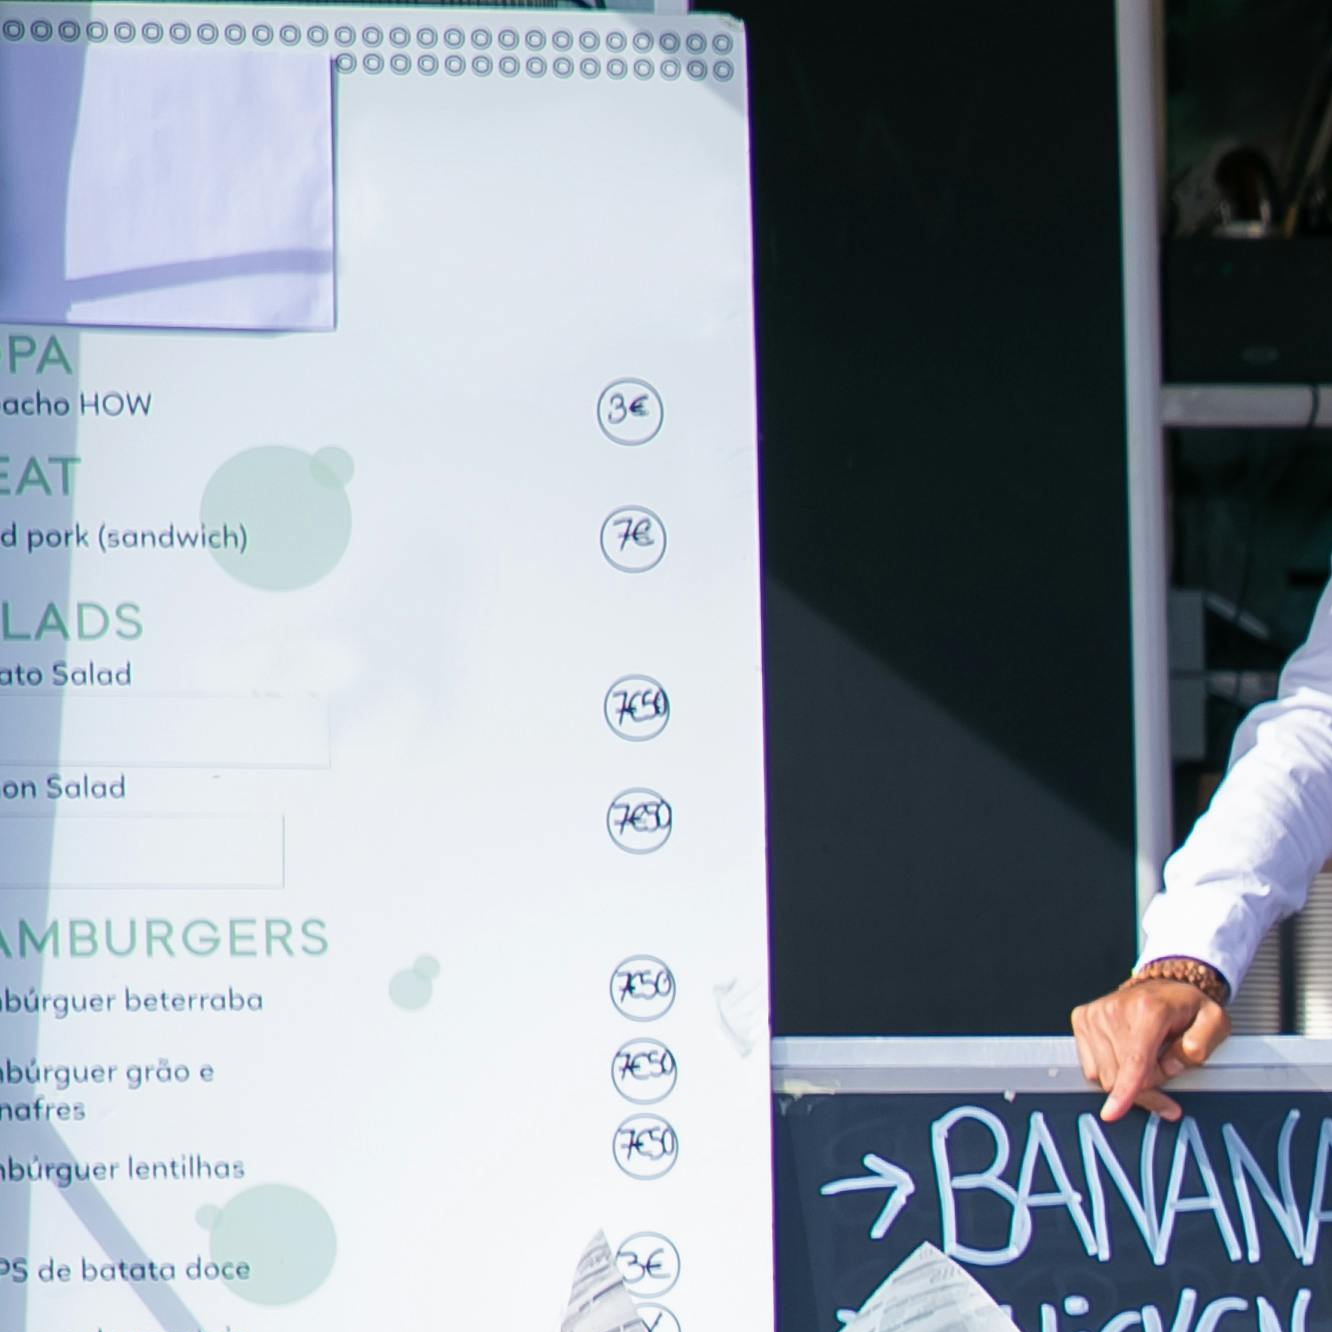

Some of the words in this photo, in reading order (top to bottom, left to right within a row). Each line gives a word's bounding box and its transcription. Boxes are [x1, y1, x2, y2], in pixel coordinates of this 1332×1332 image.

[0, 333, 72, 375] PA
[0, 389, 70, 416] acho
[80, 390, 152, 417] HOW
[607, 392, 650, 424] 3€
[28, 520, 89, 555] pork
[98, 521, 249, 555] (sandwich)
[612, 517, 655, 552] 7€
[2, 600, 143, 641] LADS
[52, 660, 131, 687] Salad
[0, 779, 36, 800] on
[46, 772, 125, 800] Salad
[0, 986, 117, 1020] búrguer
[125, 985, 264, 1013] beterraba
[0, 1057, 118, 1091] búrguer
[126, 1057, 191, 1090] grão
[199, 1063, 215, 1082] e
[0, 1154, 120, 1189] búrguer
[128, 1153, 246, 1180] lentilhas
[38, 1256, 71, 1283] de
[81, 1256, 176, 1282] batata
[185, 1255, 251, 1281] doce
[616, 1247, 672, 1283] 3€
